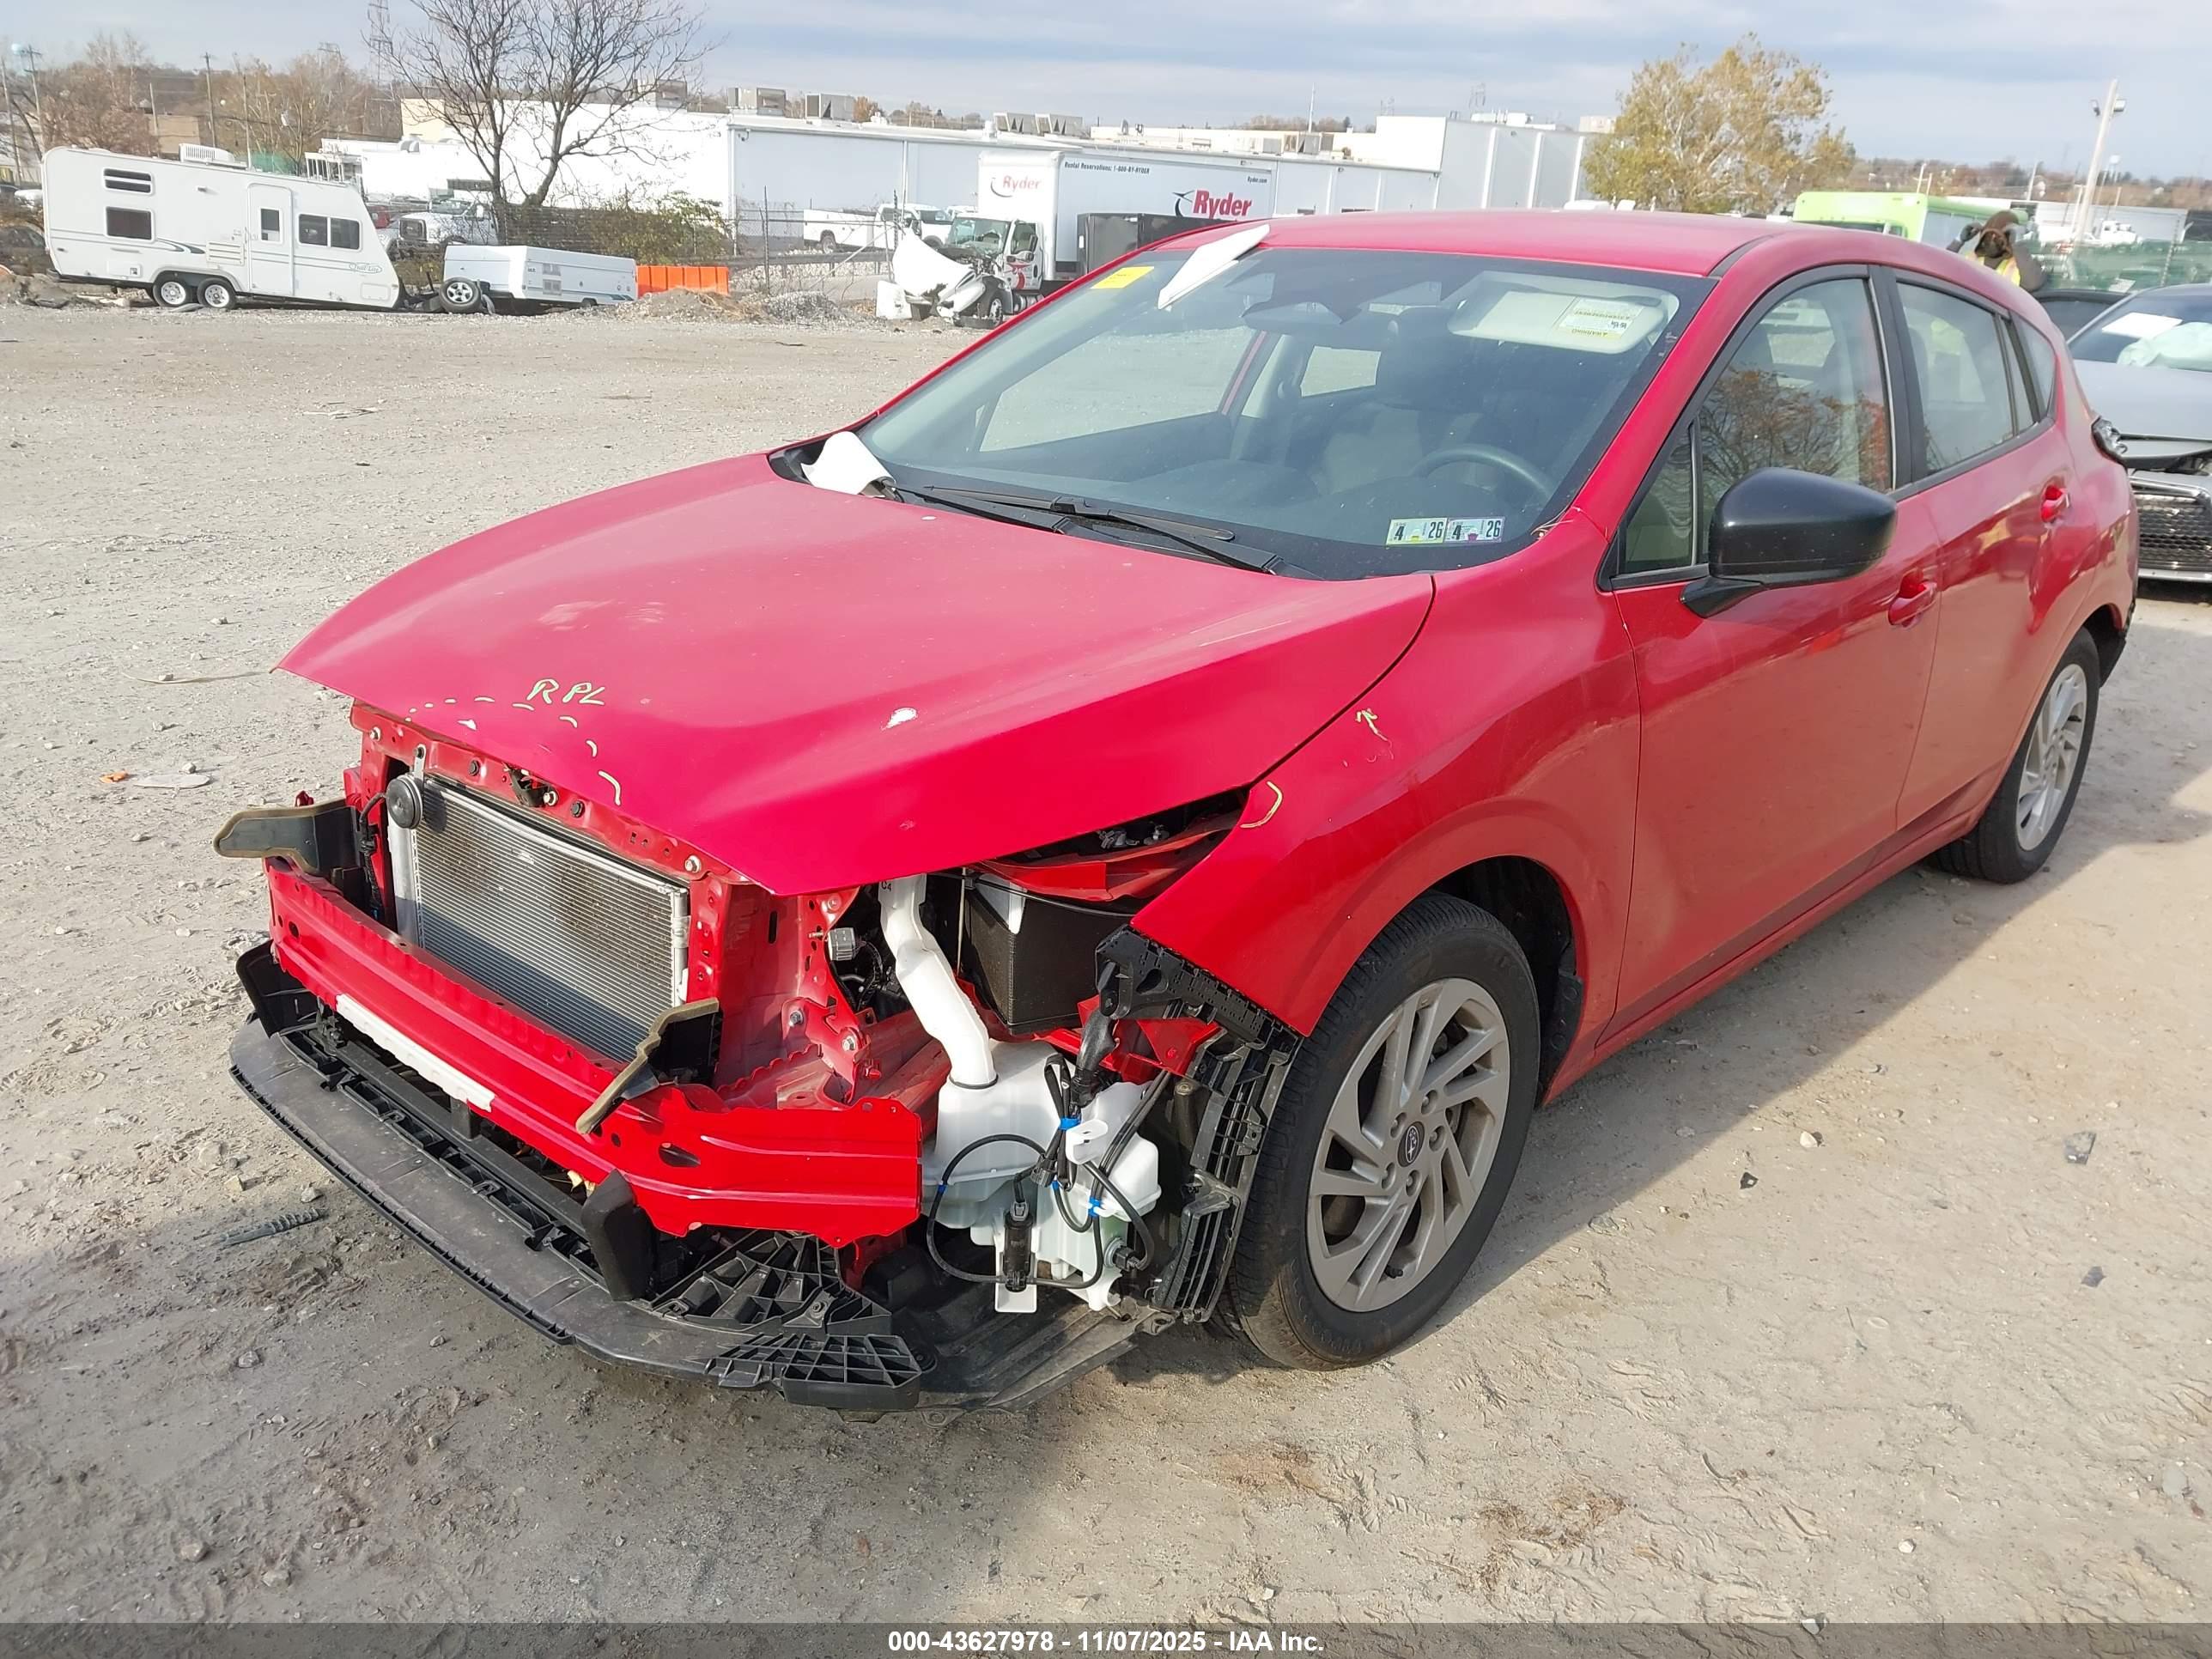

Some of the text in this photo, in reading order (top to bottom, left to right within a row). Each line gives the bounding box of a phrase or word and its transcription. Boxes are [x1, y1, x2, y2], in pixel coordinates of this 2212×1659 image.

[1002, 174, 1042, 192] Ryder
[1193, 190, 1252, 219] Ryder
[1395, 526, 1405, 540] 4
[1428, 521, 1443, 538] 26
[1453, 525, 1462, 539] 4
[1486, 520, 1501, 538] 26
